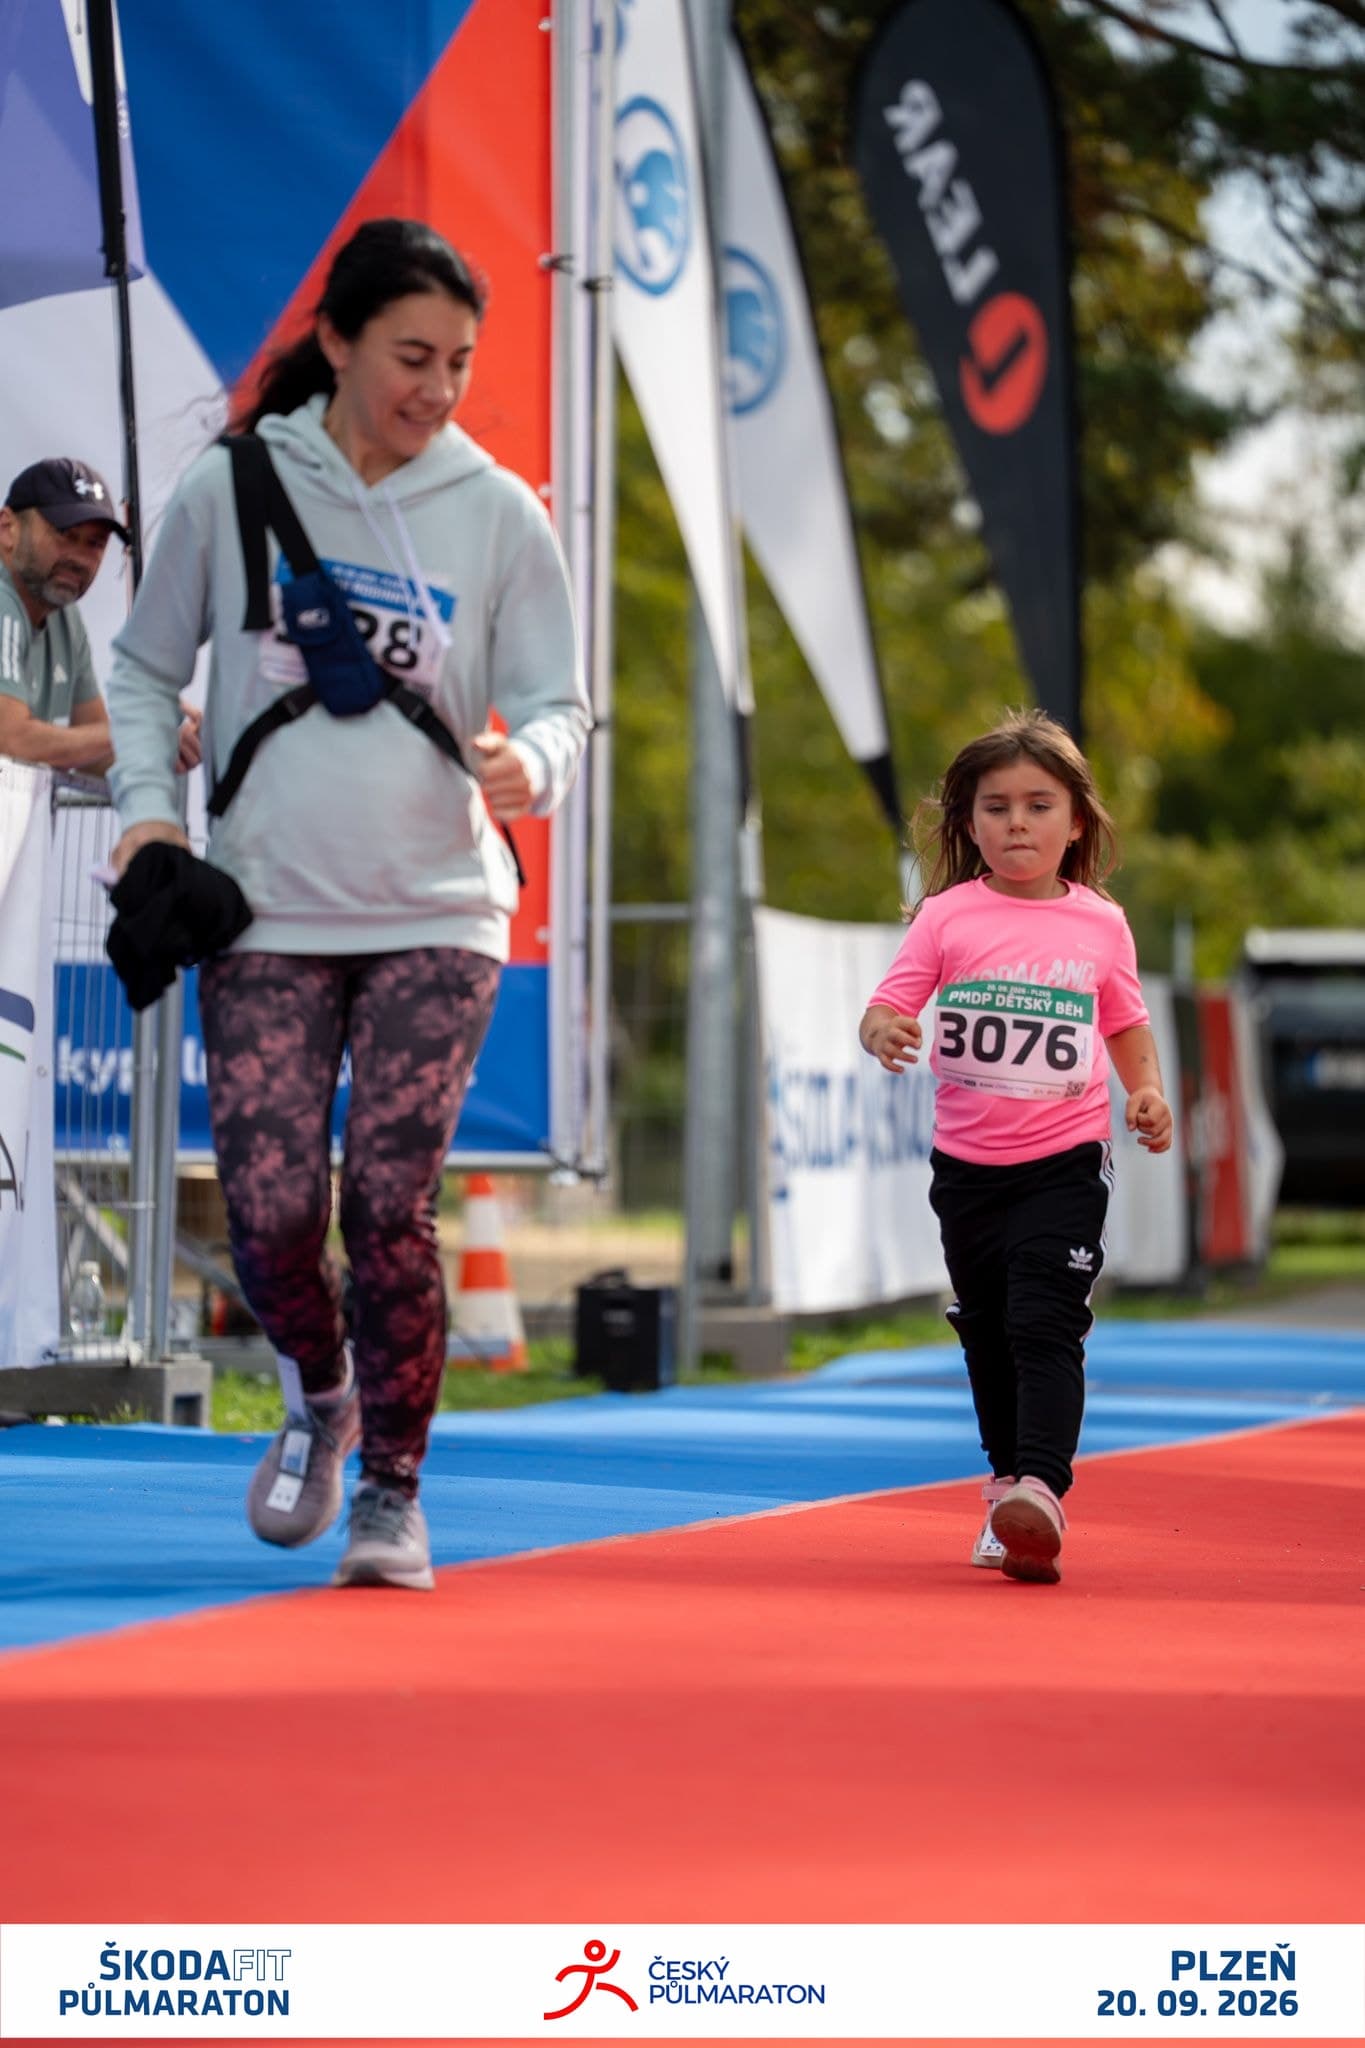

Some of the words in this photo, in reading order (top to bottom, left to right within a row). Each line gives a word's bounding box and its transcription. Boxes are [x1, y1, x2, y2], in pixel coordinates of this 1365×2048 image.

[948, 990, 993, 1006] PMDP
[995, 992, 1053, 1013] DĚTSKÝ
[1055, 1001, 1084, 1018] BĚH
[939, 1011, 1078, 1071] 3076
